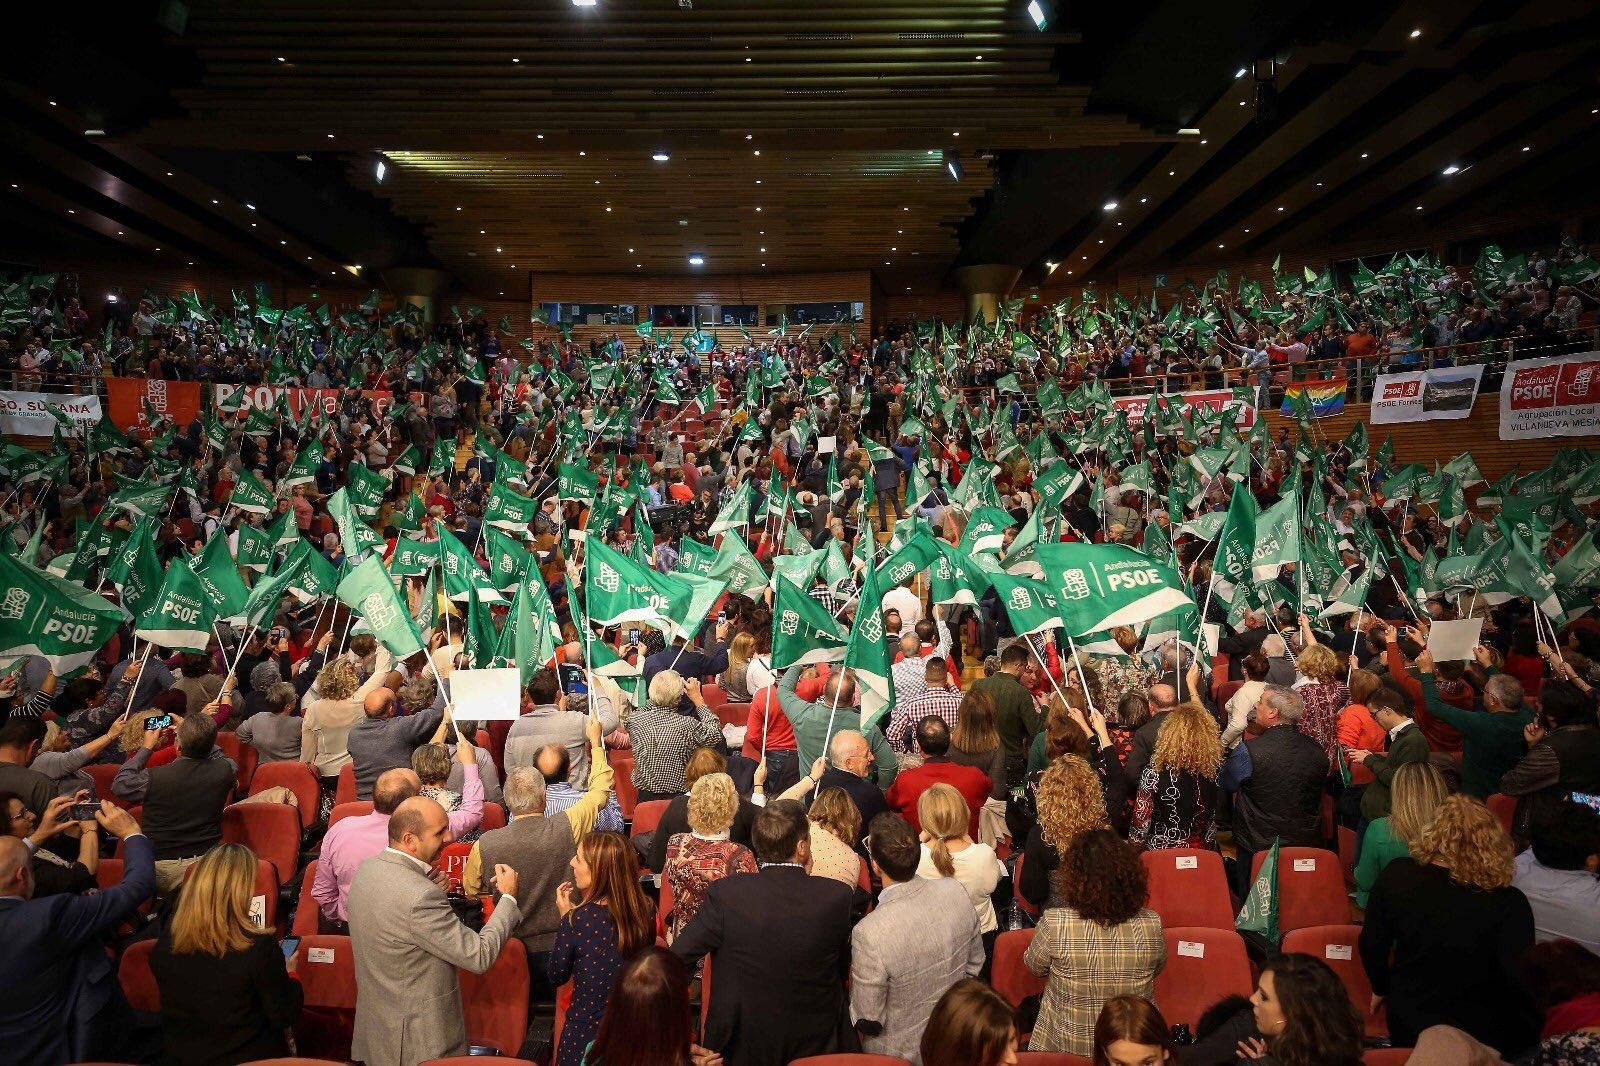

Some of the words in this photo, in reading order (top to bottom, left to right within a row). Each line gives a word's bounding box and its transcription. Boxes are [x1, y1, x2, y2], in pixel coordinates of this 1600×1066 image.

[1384, 387, 1402, 395] PSOE
[1513, 383, 1553, 400] PSOE
[27, 401, 91, 414] SUANA
[1376, 400, 1396, 408] PSOE
[1518, 408, 1567, 421] Agrupación
[1569, 405, 1595, 417] Local
[1511, 420, 1568, 432] VILLANUEVA
[291, 467, 308, 475] PSOE
[1057, 474, 1073, 488] PSOE
[250, 490, 267, 505] PSOE
[504, 509, 523, 520] PSOE
[357, 529, 377, 542] SOE
[1107, 569, 1163, 591] PSOE
[53, 606, 96, 620] Andalucía
[161, 601, 201, 625] PSOE
[43, 618, 98, 644] PSOE
